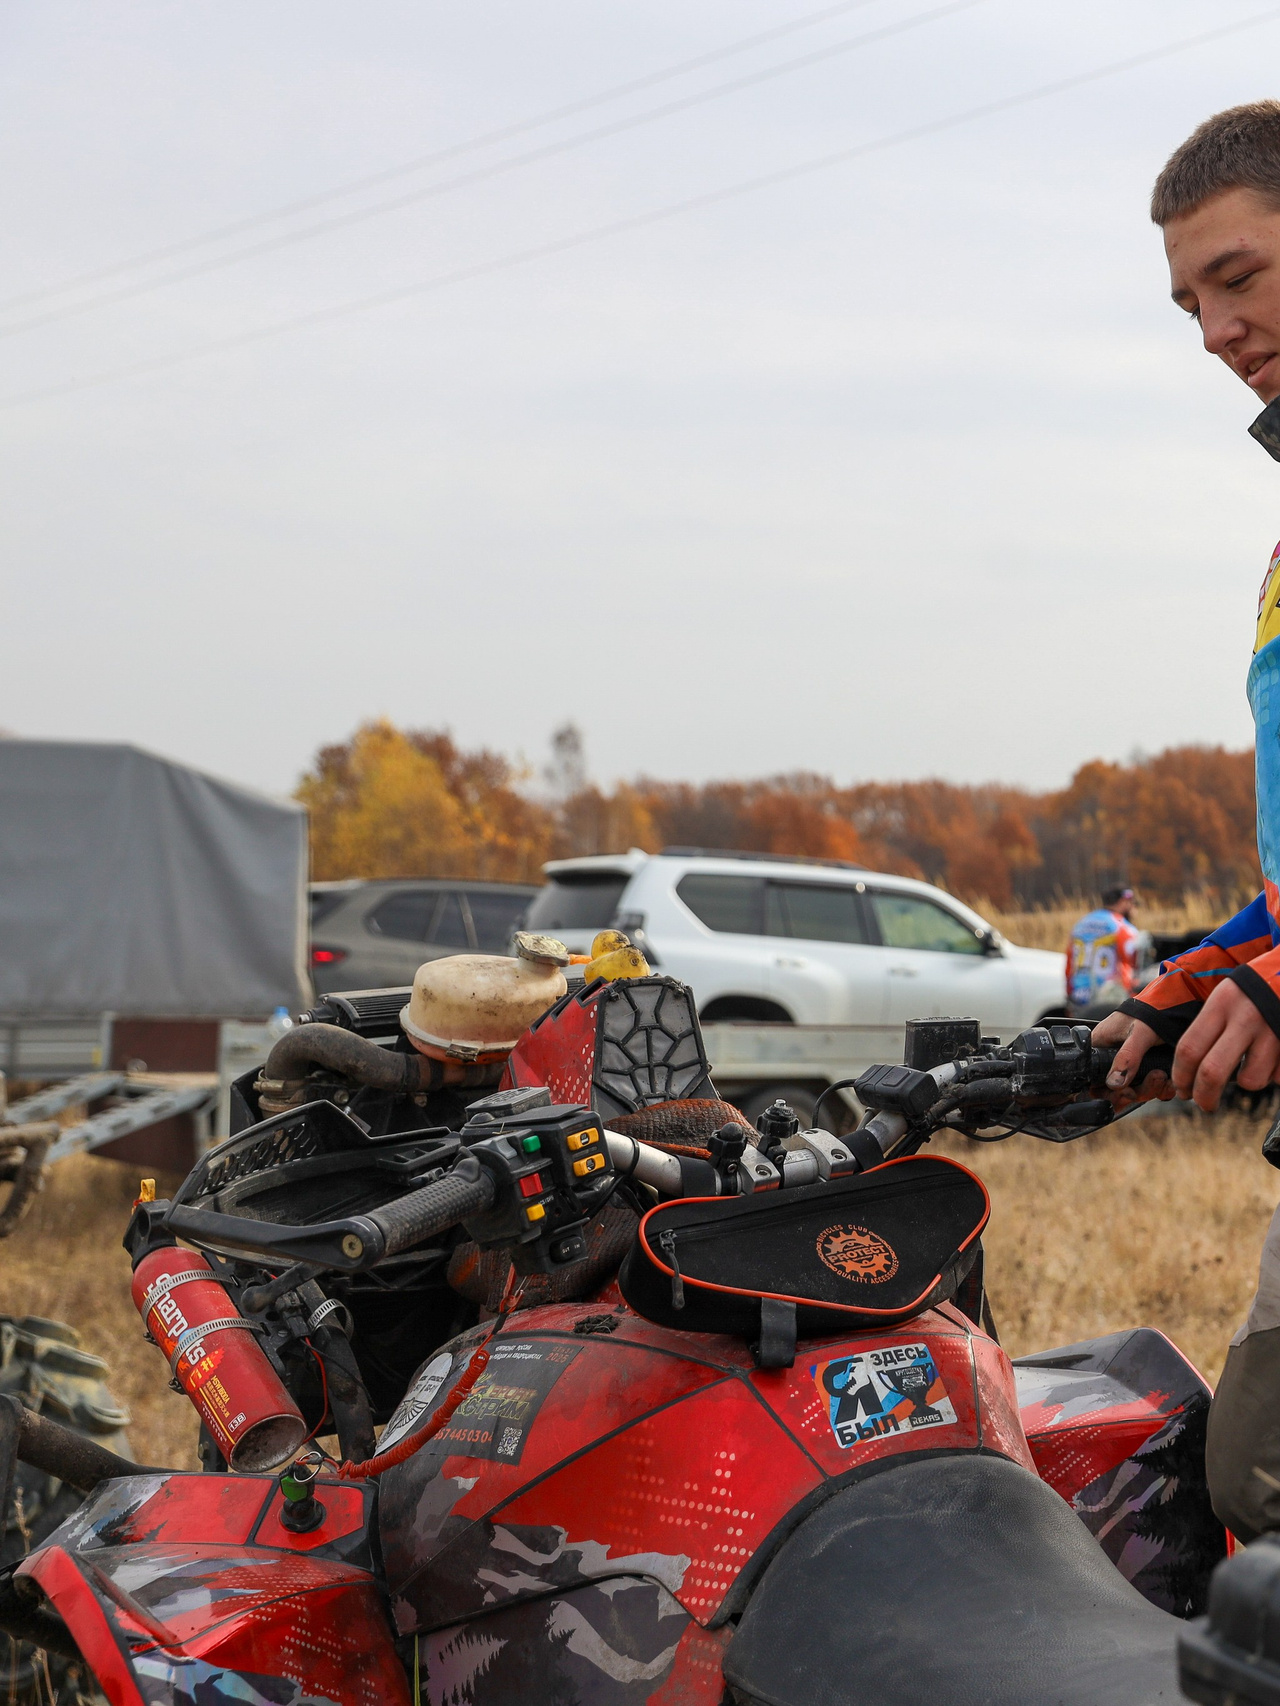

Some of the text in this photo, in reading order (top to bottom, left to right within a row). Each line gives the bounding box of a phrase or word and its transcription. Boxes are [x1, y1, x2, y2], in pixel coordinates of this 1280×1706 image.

[816, 1224, 868, 1243] BICYCLES CLUB
[827, 1245, 886, 1263] PROTECT
[837, 1259, 899, 1284] QUALITY ACCESSORIES
[869, 1345, 928, 1367] ЗДЕСЬ
[836, 1413, 900, 1446] БЫЛ
